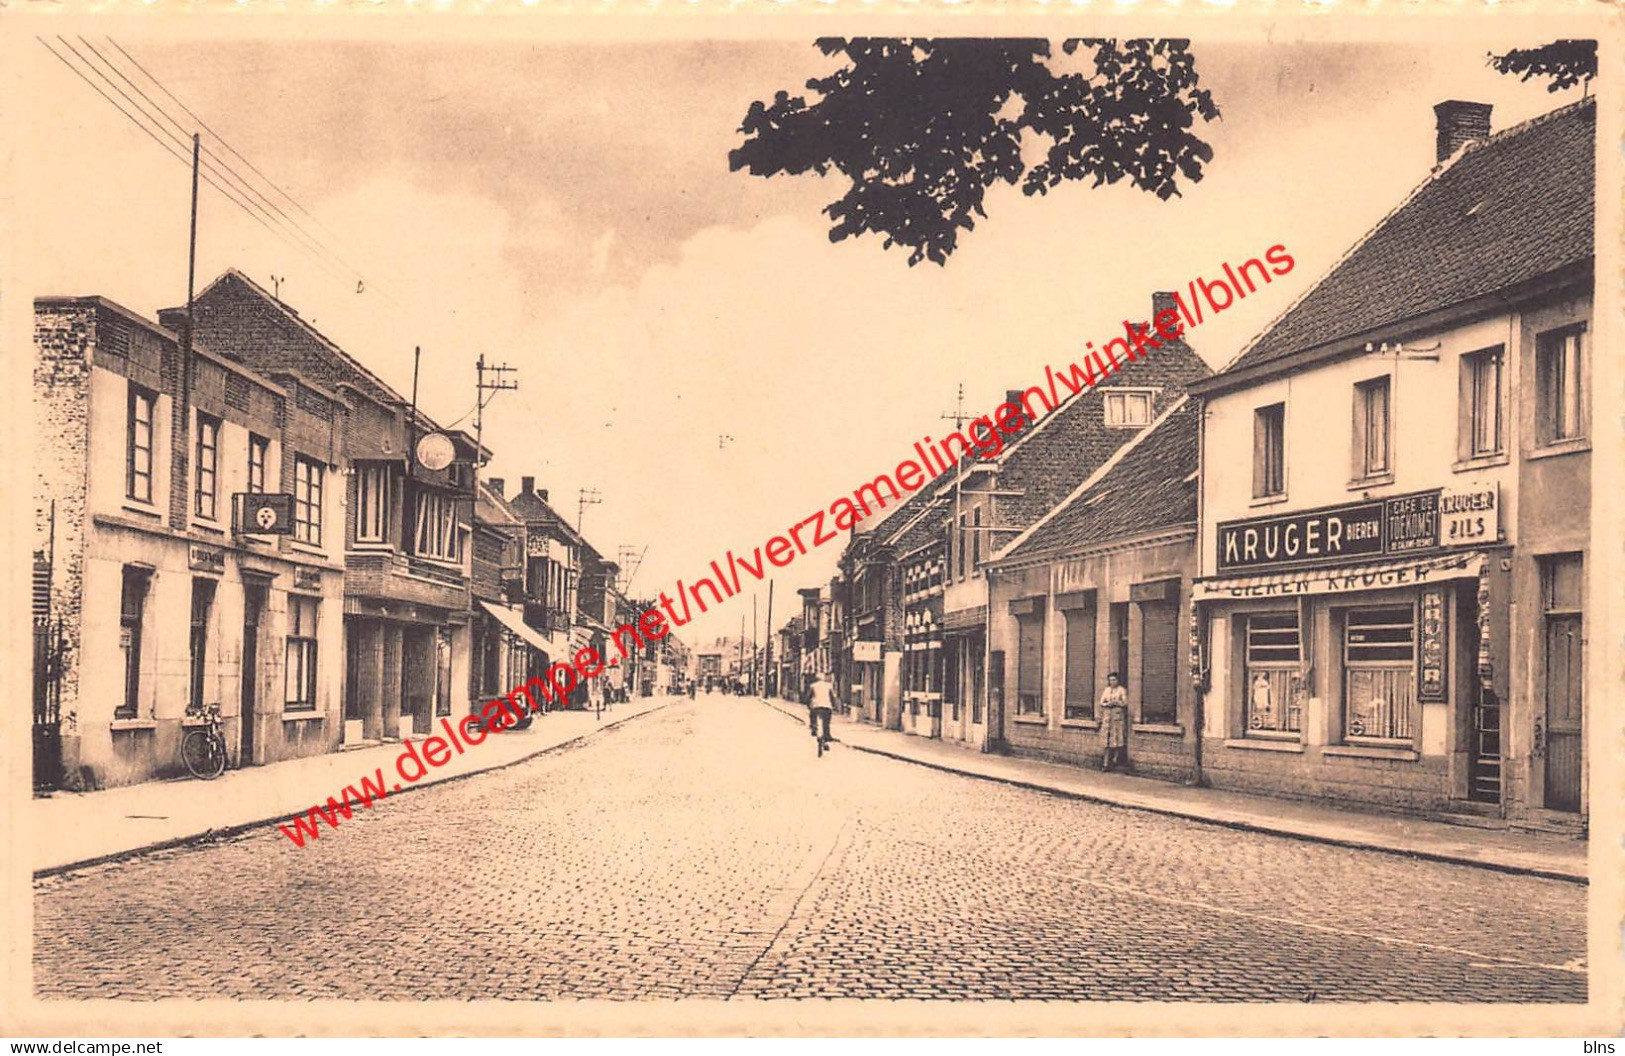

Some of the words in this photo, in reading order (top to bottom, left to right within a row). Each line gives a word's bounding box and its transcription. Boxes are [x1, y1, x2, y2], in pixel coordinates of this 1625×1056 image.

[1225, 517, 1342, 563] KRUGER
[1346, 520, 1379, 541] BIEREN
[1449, 517, 1485, 538] PILS
